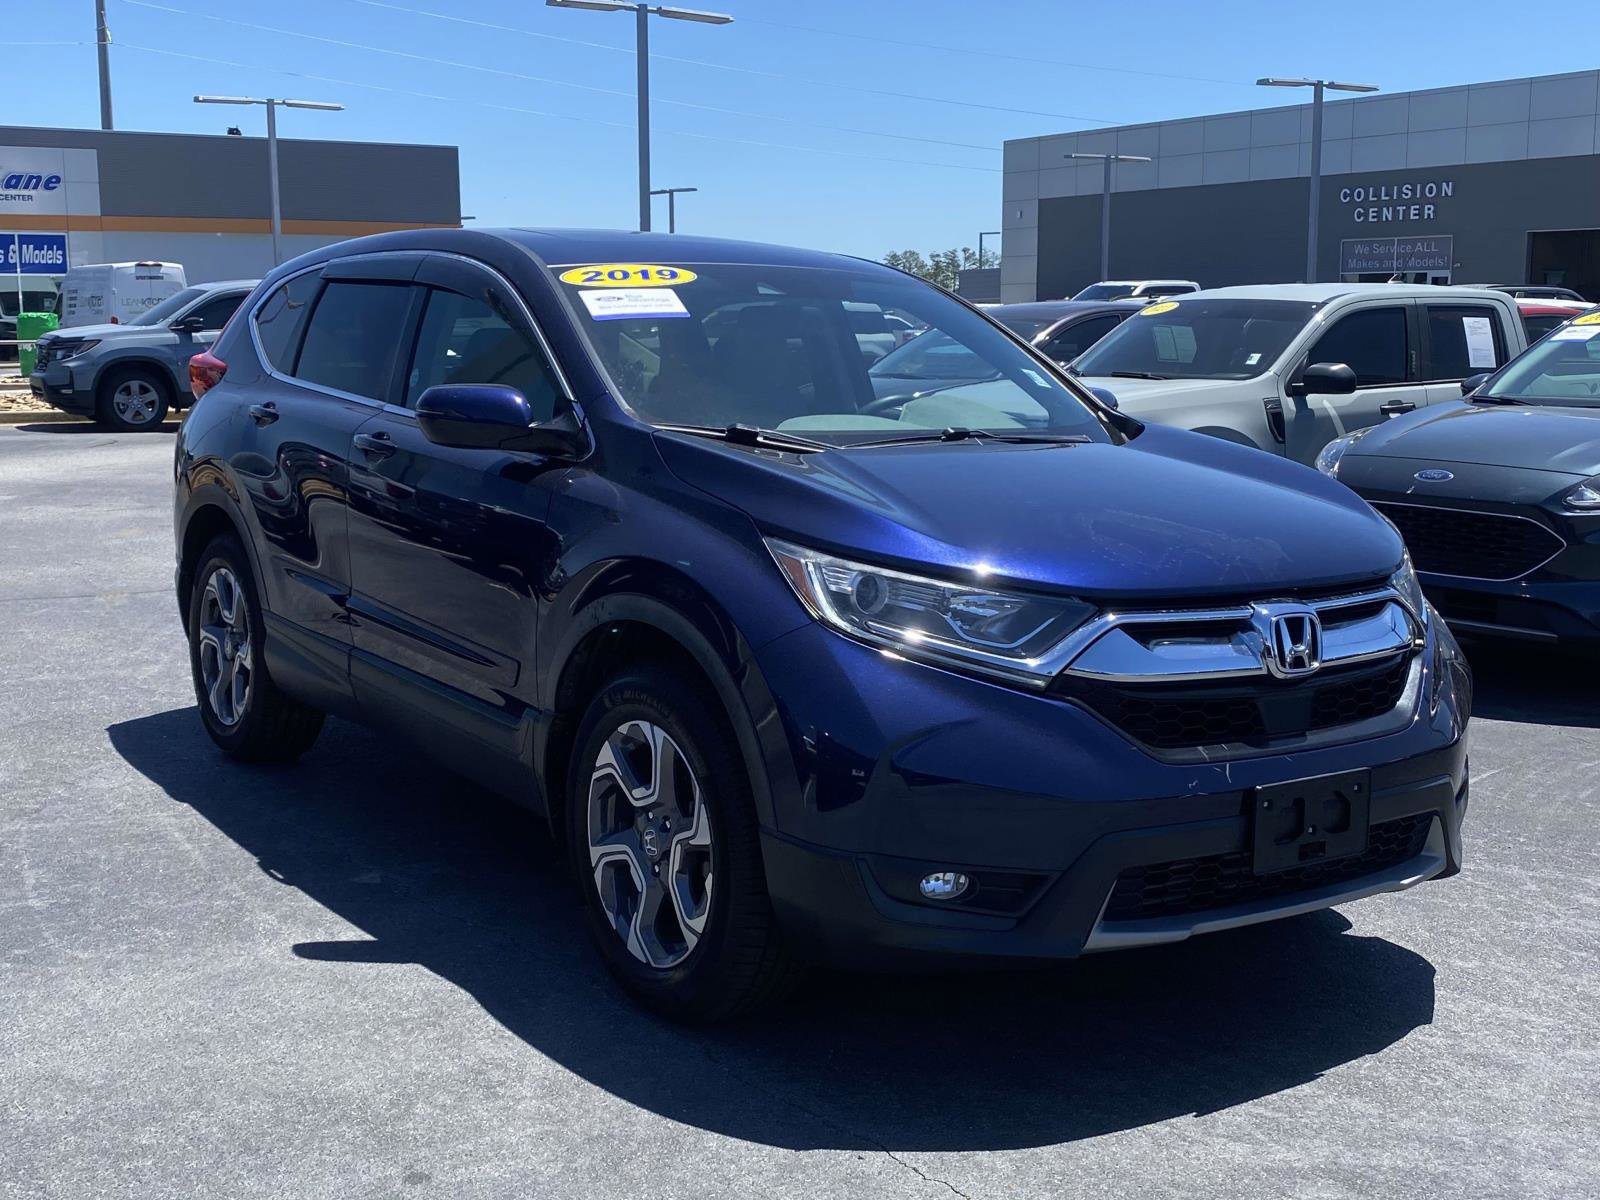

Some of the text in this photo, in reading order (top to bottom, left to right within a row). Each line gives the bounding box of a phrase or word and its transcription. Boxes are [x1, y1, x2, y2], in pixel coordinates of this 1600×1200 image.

[1340, 182, 1452, 202] COLLISION
[1354, 205, 1434, 222] CENTER
[22, 244, 63, 264] Models
[1354, 242, 1440, 255] We Service ALL
[1348, 256, 1448, 269] Makes and Models!
[581, 269, 678, 282] 2019
